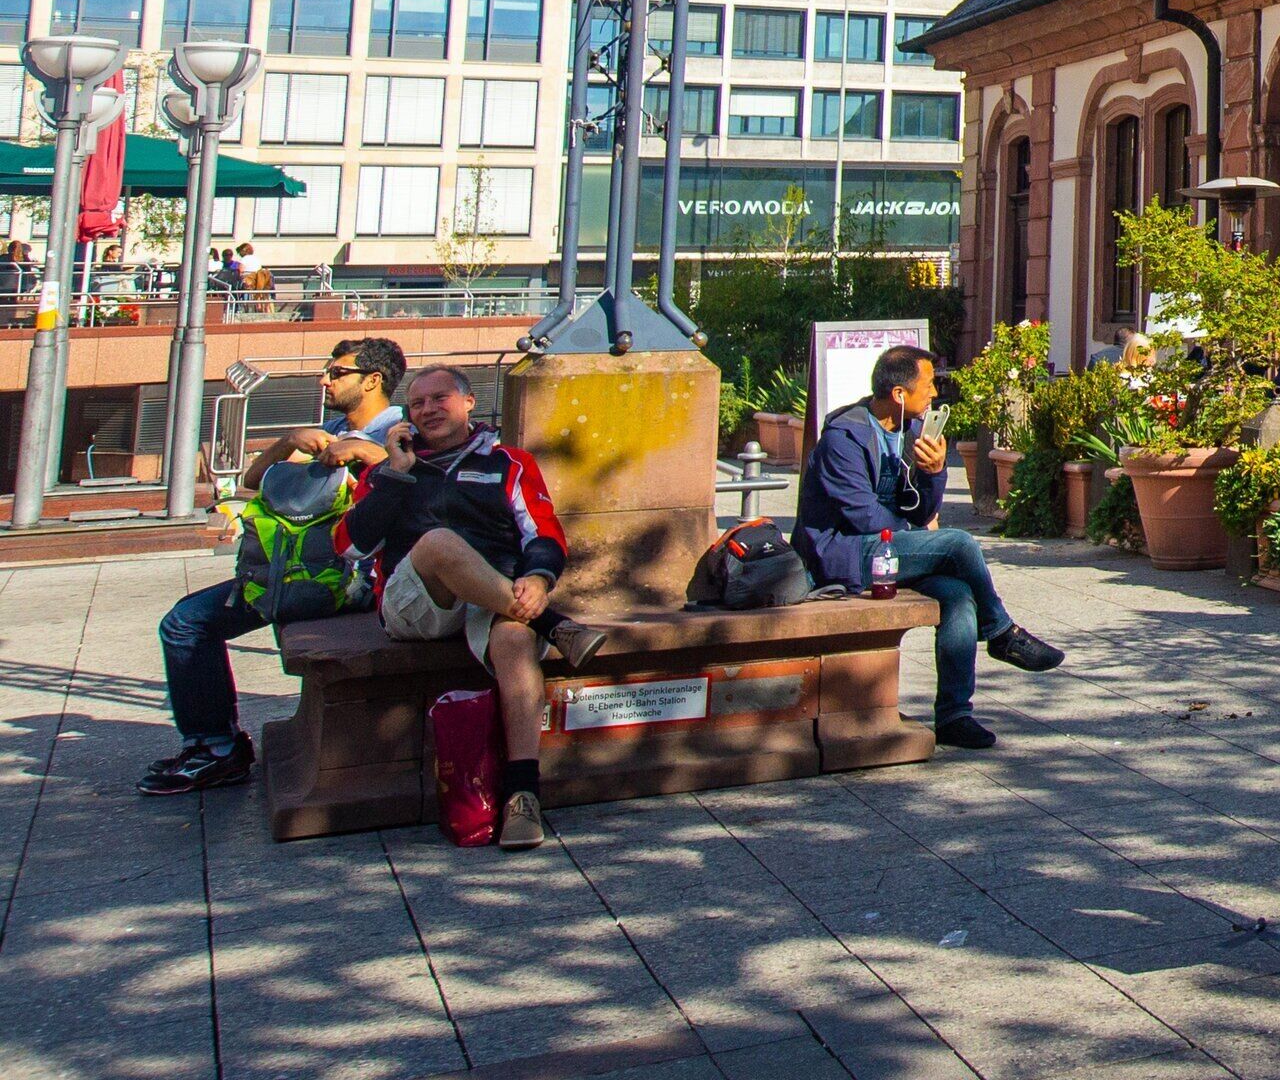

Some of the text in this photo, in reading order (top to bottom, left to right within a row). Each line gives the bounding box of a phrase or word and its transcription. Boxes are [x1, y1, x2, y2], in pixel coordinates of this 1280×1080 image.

[924, 201, 960, 215] JON
[578, 685, 702, 701] oteinspeisung Sprinkleranlage
[625, 698, 657, 708] U-Bahn
[658, 696, 687, 706] Station
[612, 709, 662, 720] Hauptwache
